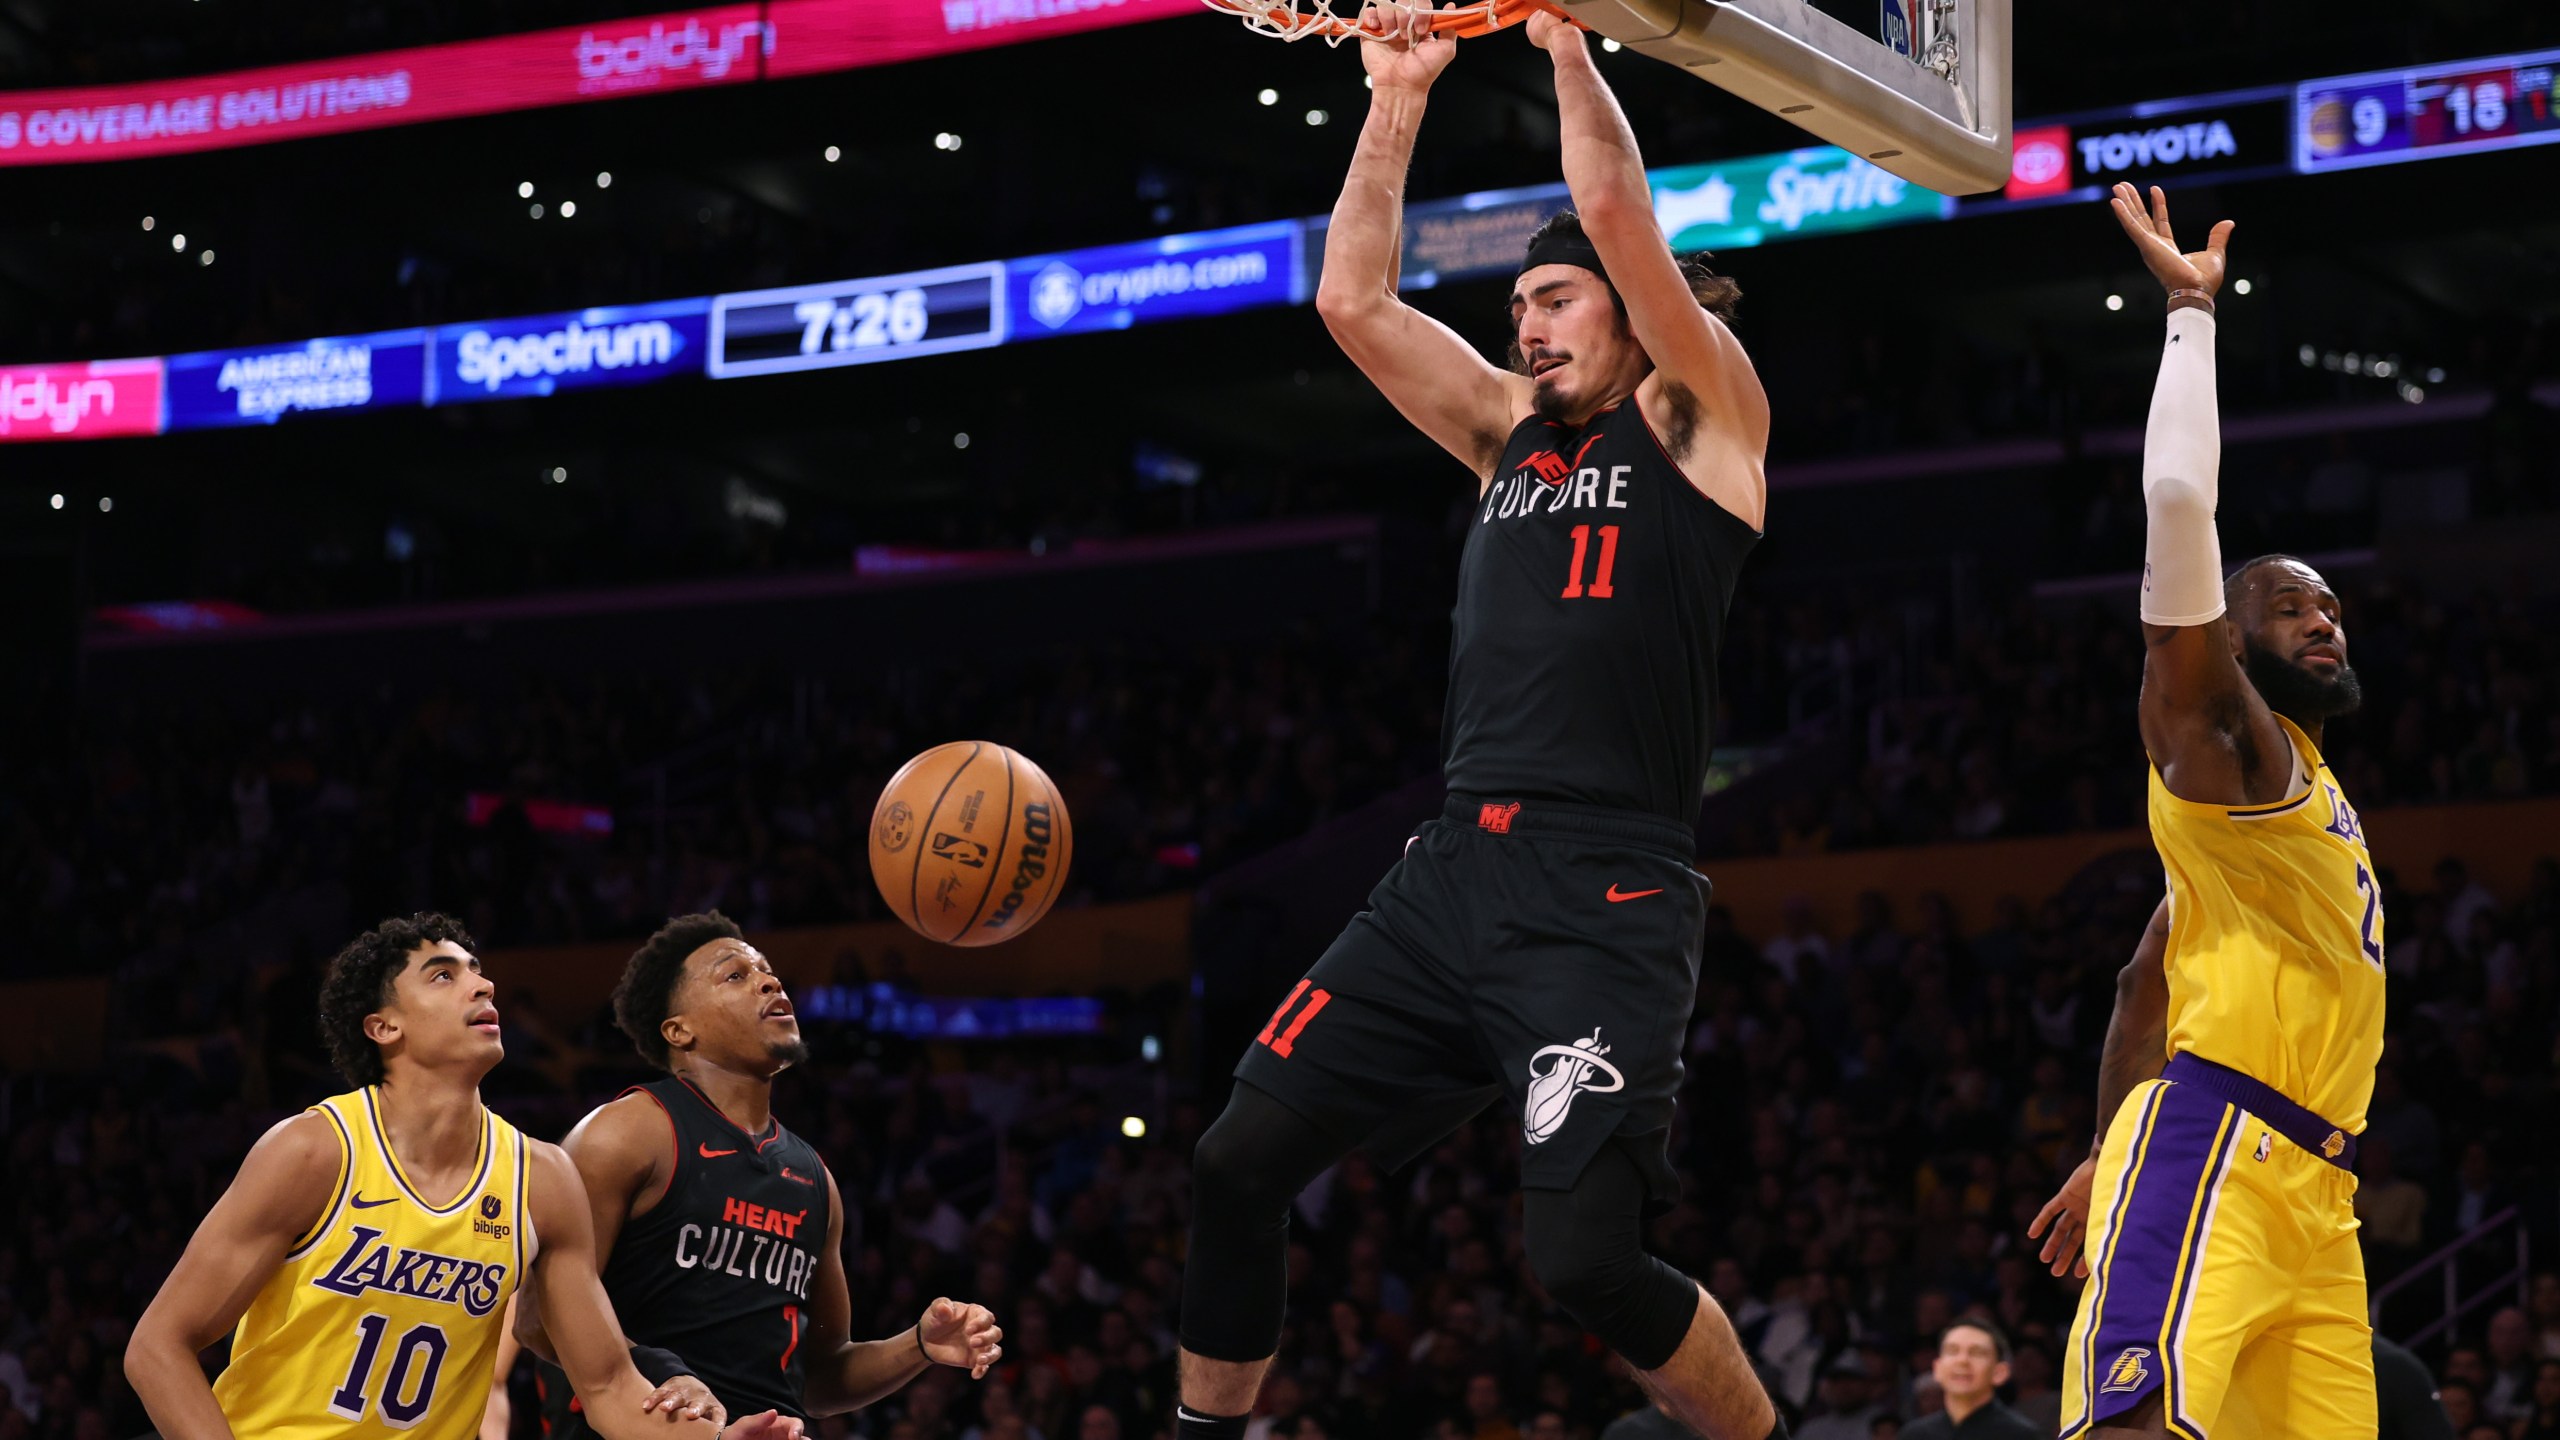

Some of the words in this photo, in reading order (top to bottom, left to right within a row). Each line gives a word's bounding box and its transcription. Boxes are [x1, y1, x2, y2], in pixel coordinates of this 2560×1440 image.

[574, 18, 777, 78] boldyn
[1886, 12, 1905, 46] NBA
[26, 95, 215, 146] COVERAGE
[218, 69, 411, 130] SOLUTIONS
[2352, 95, 2388, 147] 9
[2445, 80, 2508, 134] 18
[2076, 120, 2238, 174] TOYOTA
[1757, 154, 1909, 231] Sprite
[1082, 250, 1267, 307] crypto.com
[794, 286, 928, 354] 7:26
[216, 344, 371, 392] AMERICAN
[457, 319, 672, 392] Spectrum
[237, 377, 372, 417] EXPRESS
[1483, 465, 1632, 524] CULTURE
[1560, 523, 1620, 599] 11
[982, 802, 1051, 928] Wilson
[1257, 978, 1332, 1059] 11
[474, 1219, 510, 1239] bibigo
[723, 1197, 807, 1239] HEAT
[675, 1223, 817, 1300] CULTURE
[780, 1304, 798, 1372] 7
[327, 1311, 451, 1431] 10
